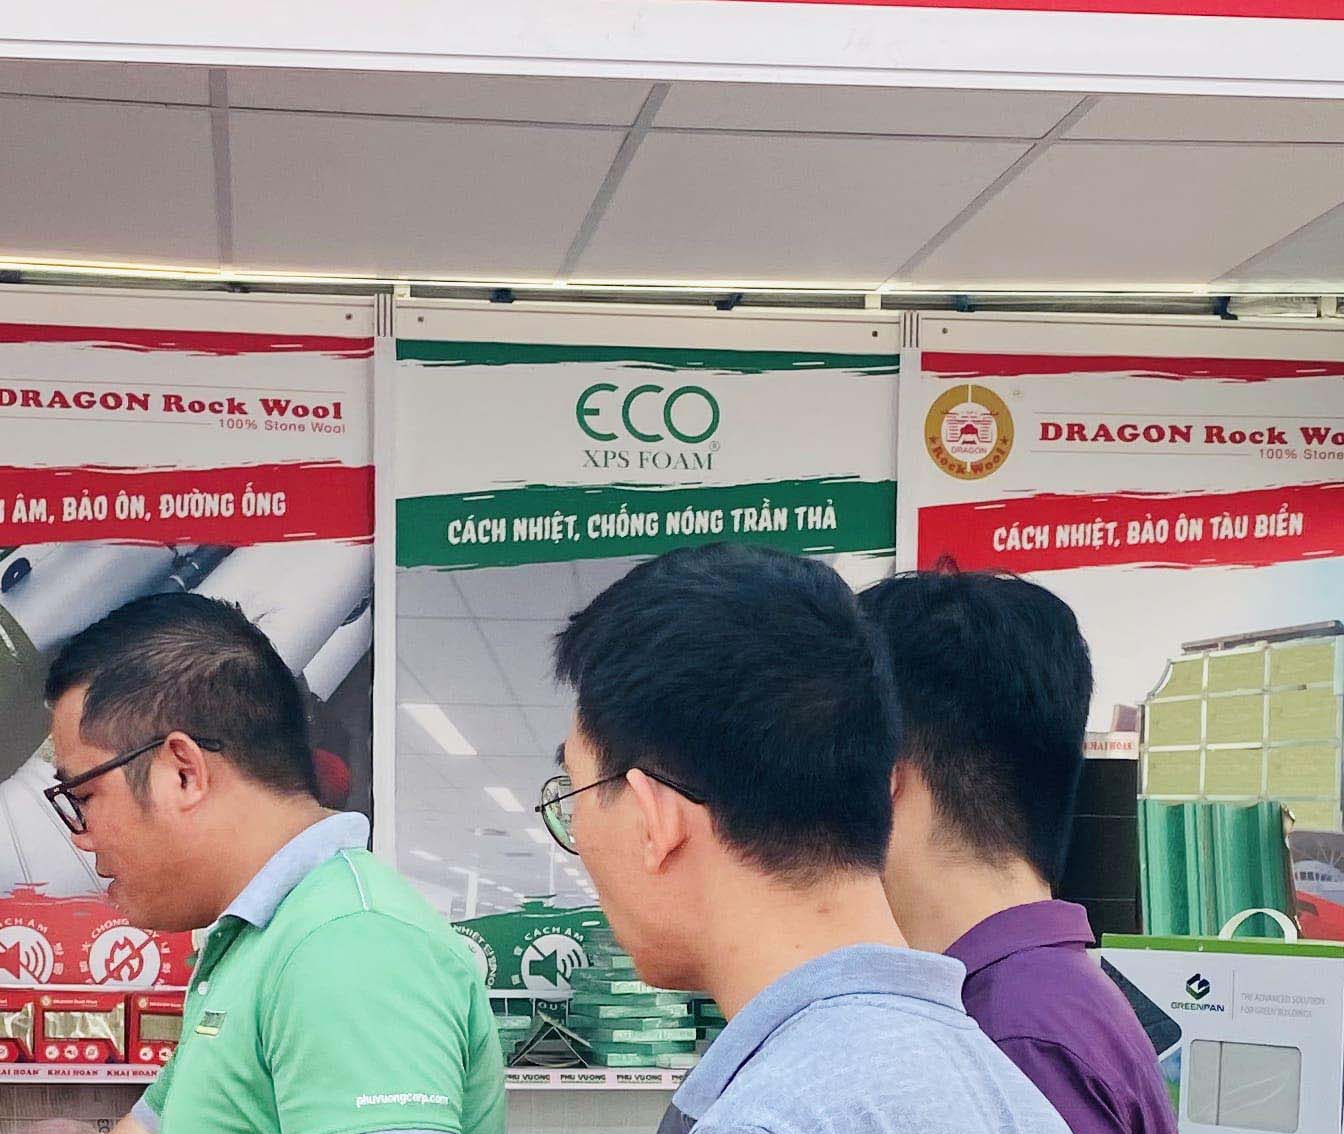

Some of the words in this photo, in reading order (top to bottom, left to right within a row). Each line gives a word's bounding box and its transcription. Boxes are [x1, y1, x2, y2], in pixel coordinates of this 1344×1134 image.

[162, 394, 248, 416] Rock
[259, 398, 343, 420] Wool
[576, 383, 720, 444] ECO
[218, 418, 258, 431] 100%
[263, 420, 305, 432] Stone
[310, 421, 346, 434] Wool
[1039, 421, 1193, 444] DRAGON
[1204, 425, 1288, 446] Rock
[582, 448, 630, 469] XPS
[638, 450, 714, 471] FOAM
[1259, 448, 1298, 460] 100%
[1303, 449, 1344, 461] Stone
[11, 492, 54, 525] ÂM,
[62, 488, 108, 522] BẢO
[115, 490, 151, 522] ÔN,
[158, 488, 234, 519] ĐƯỜNG
[241, 482, 286, 516] ỐNG
[448, 511, 507, 545] CÁCH
[513, 510, 581, 542] NHIỆT,
[587, 503, 659, 539] CHỐNG
[665, 503, 724, 535] NÓNG
[730, 497, 787, 532] TRẦN
[794, 498, 837, 530] THẢ
[992, 521, 1050, 553] CÁCH
[1055, 517, 1120, 550] NHIỆT,
[1126, 512, 1169, 545] BẢO
[1174, 516, 1203, 544] ÔN
[1209, 510, 1248, 540] TÀU
[1254, 502, 1304, 538] BIỂN
[1171, 1001, 1224, 1013] GREENPAN
